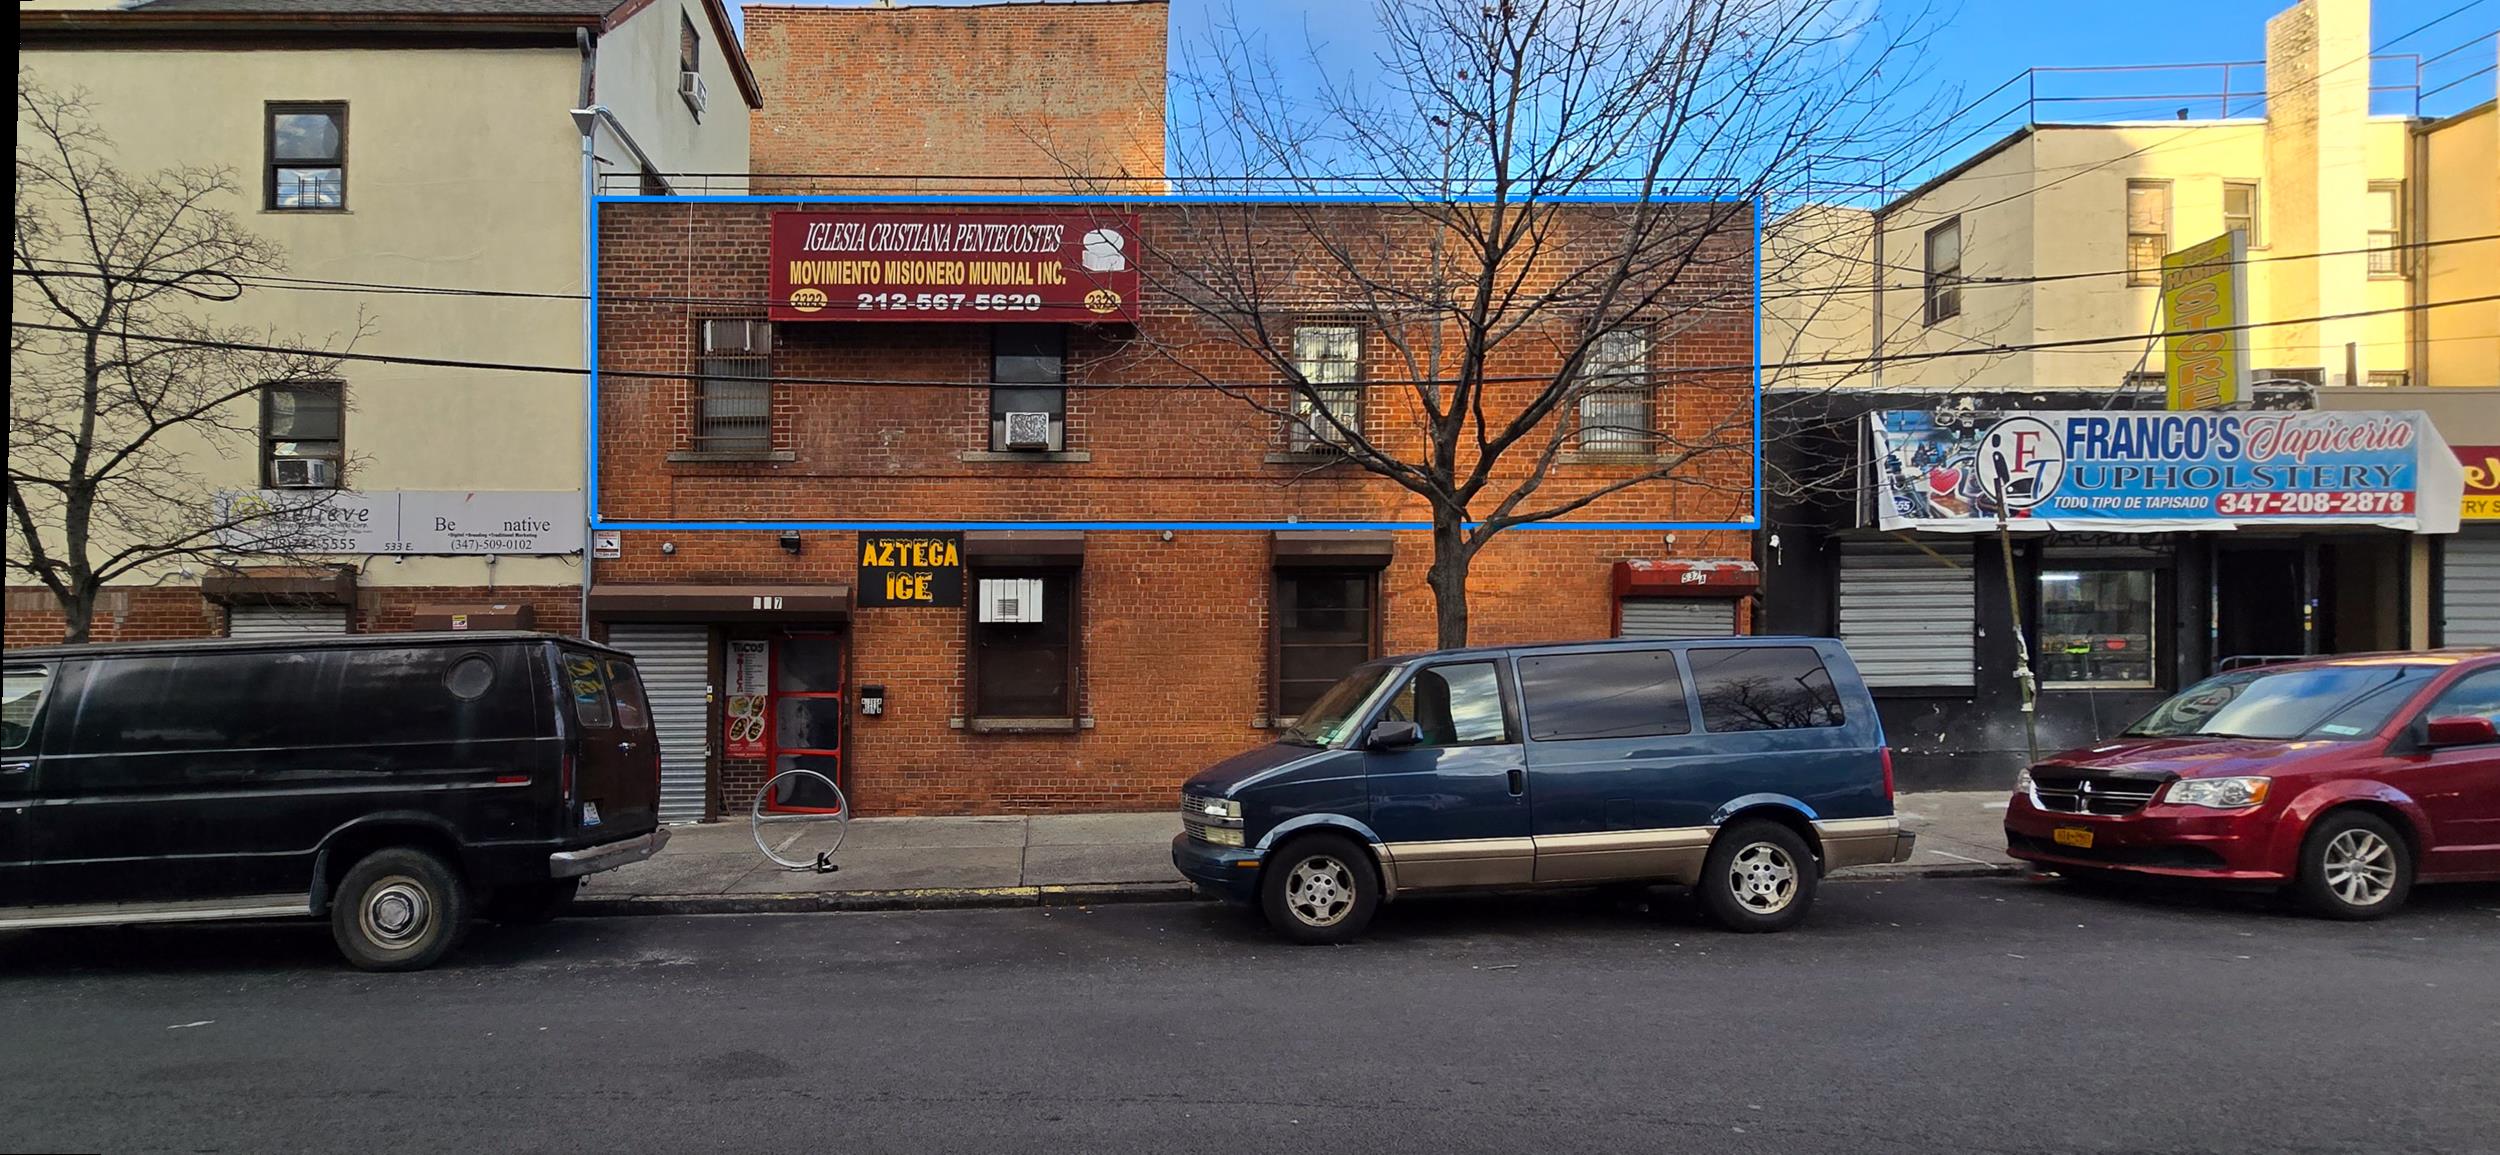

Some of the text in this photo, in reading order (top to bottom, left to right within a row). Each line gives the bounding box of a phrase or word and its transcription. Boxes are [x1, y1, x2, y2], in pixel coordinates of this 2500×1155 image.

[803, 222, 1065, 253] IGLESIA CRISTIANA PENTECOSTES
[790, 260, 1067, 286] MOVIMIENTO MISIONERO MUNDIAL INC.
[857, 293, 1041, 311] 212-567-5620
[2174, 283, 2227, 411] STORE
[2066, 416, 2241, 460] FRANCO'S
[2073, 465, 2406, 490] UPHOLSTERY
[2054, 496, 2209, 509] TODO TIPO DE TAPISADO
[2220, 492, 2405, 513] 347-208-2878
[435, 516, 551, 532] Be native
[451, 539, 532, 551] (347)-509-0102
[862, 538, 959, 567] AZTECA
[886, 571, 933, 600] ICE
